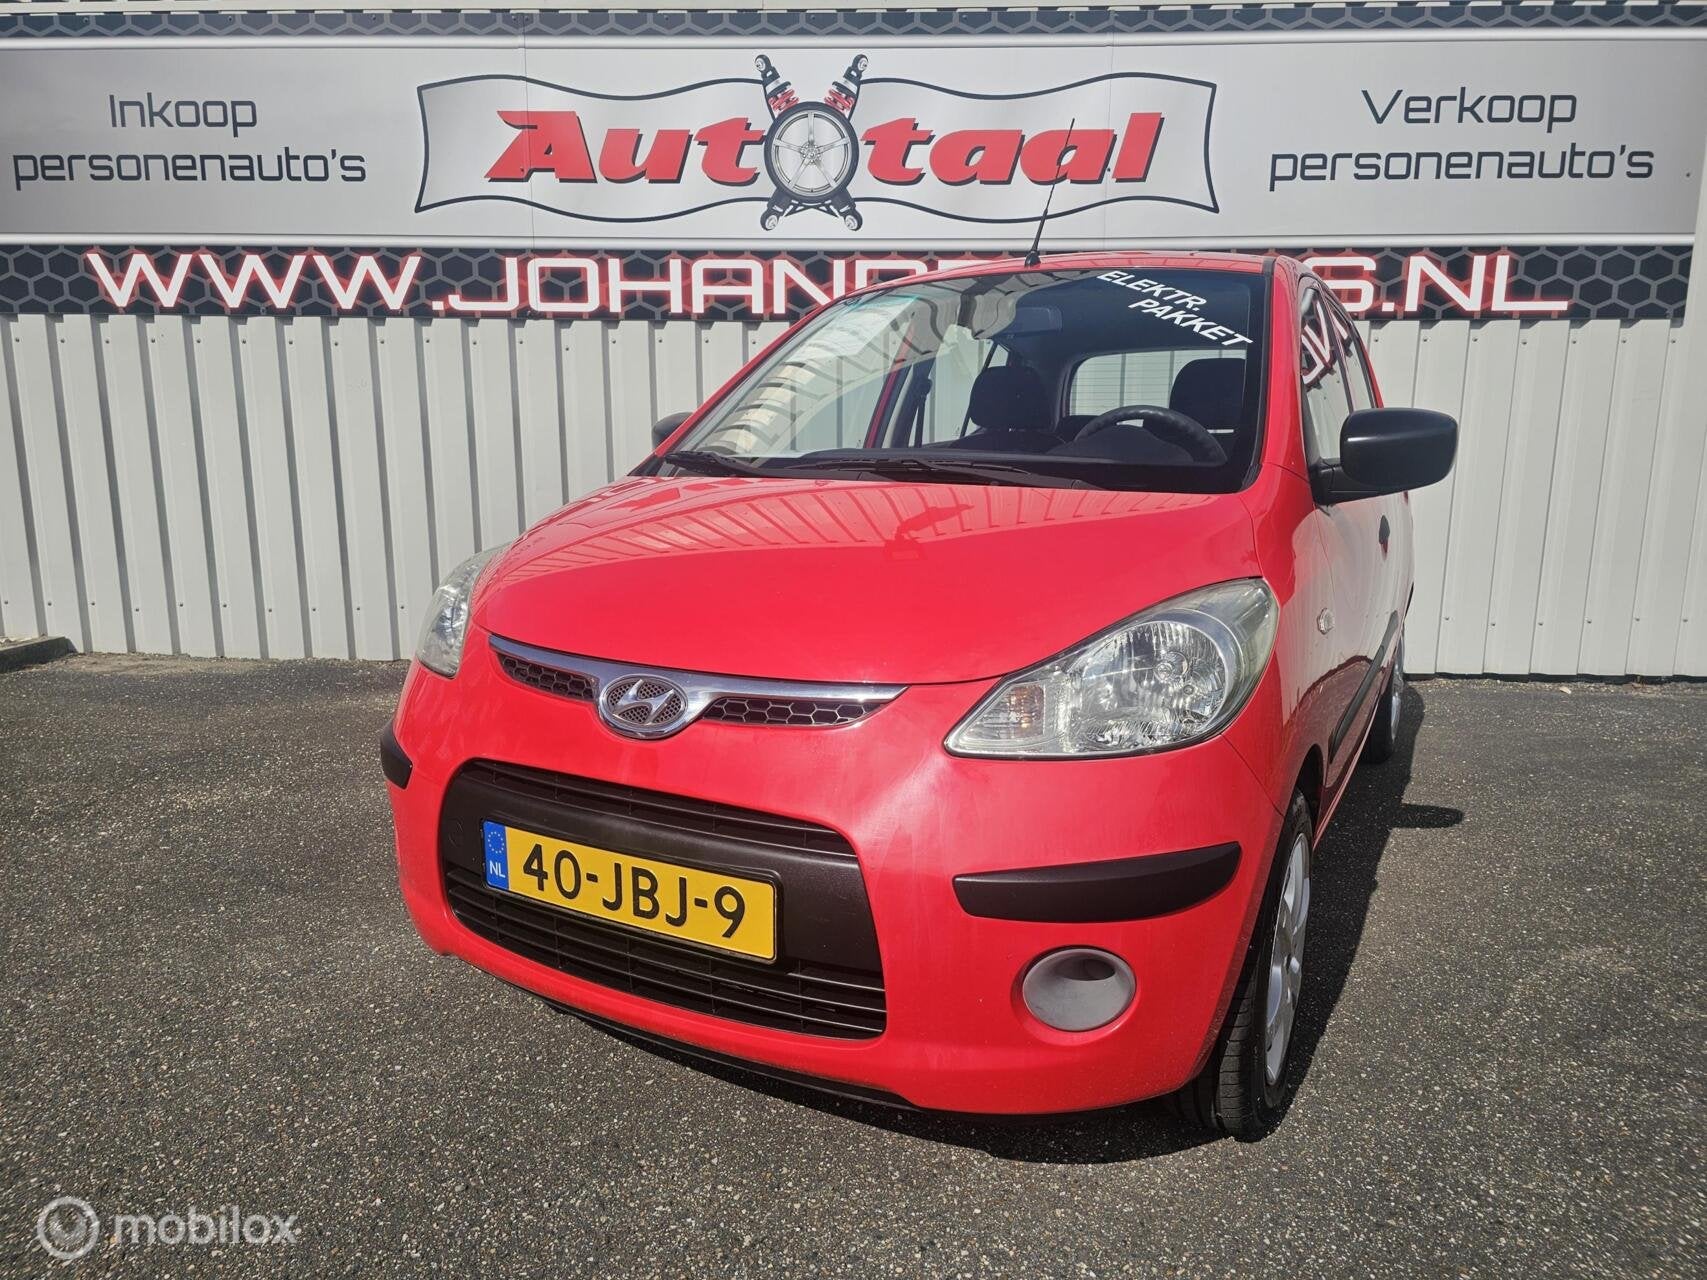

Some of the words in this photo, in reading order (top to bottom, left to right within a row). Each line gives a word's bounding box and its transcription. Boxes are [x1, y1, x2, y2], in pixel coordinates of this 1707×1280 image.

[109, 92, 257, 138] Inkoop
[1361, 86, 1577, 133] Verkoop
[13, 146, 366, 191] personenauto's
[1269, 142, 1655, 192] personenauto's
[1097, 270, 1207, 311] ELEKTR.
[1128, 299, 1253, 346] PAKKET
[489, 860, 506, 878] NL
[523, 843, 745, 938] 40-JBJ-9
